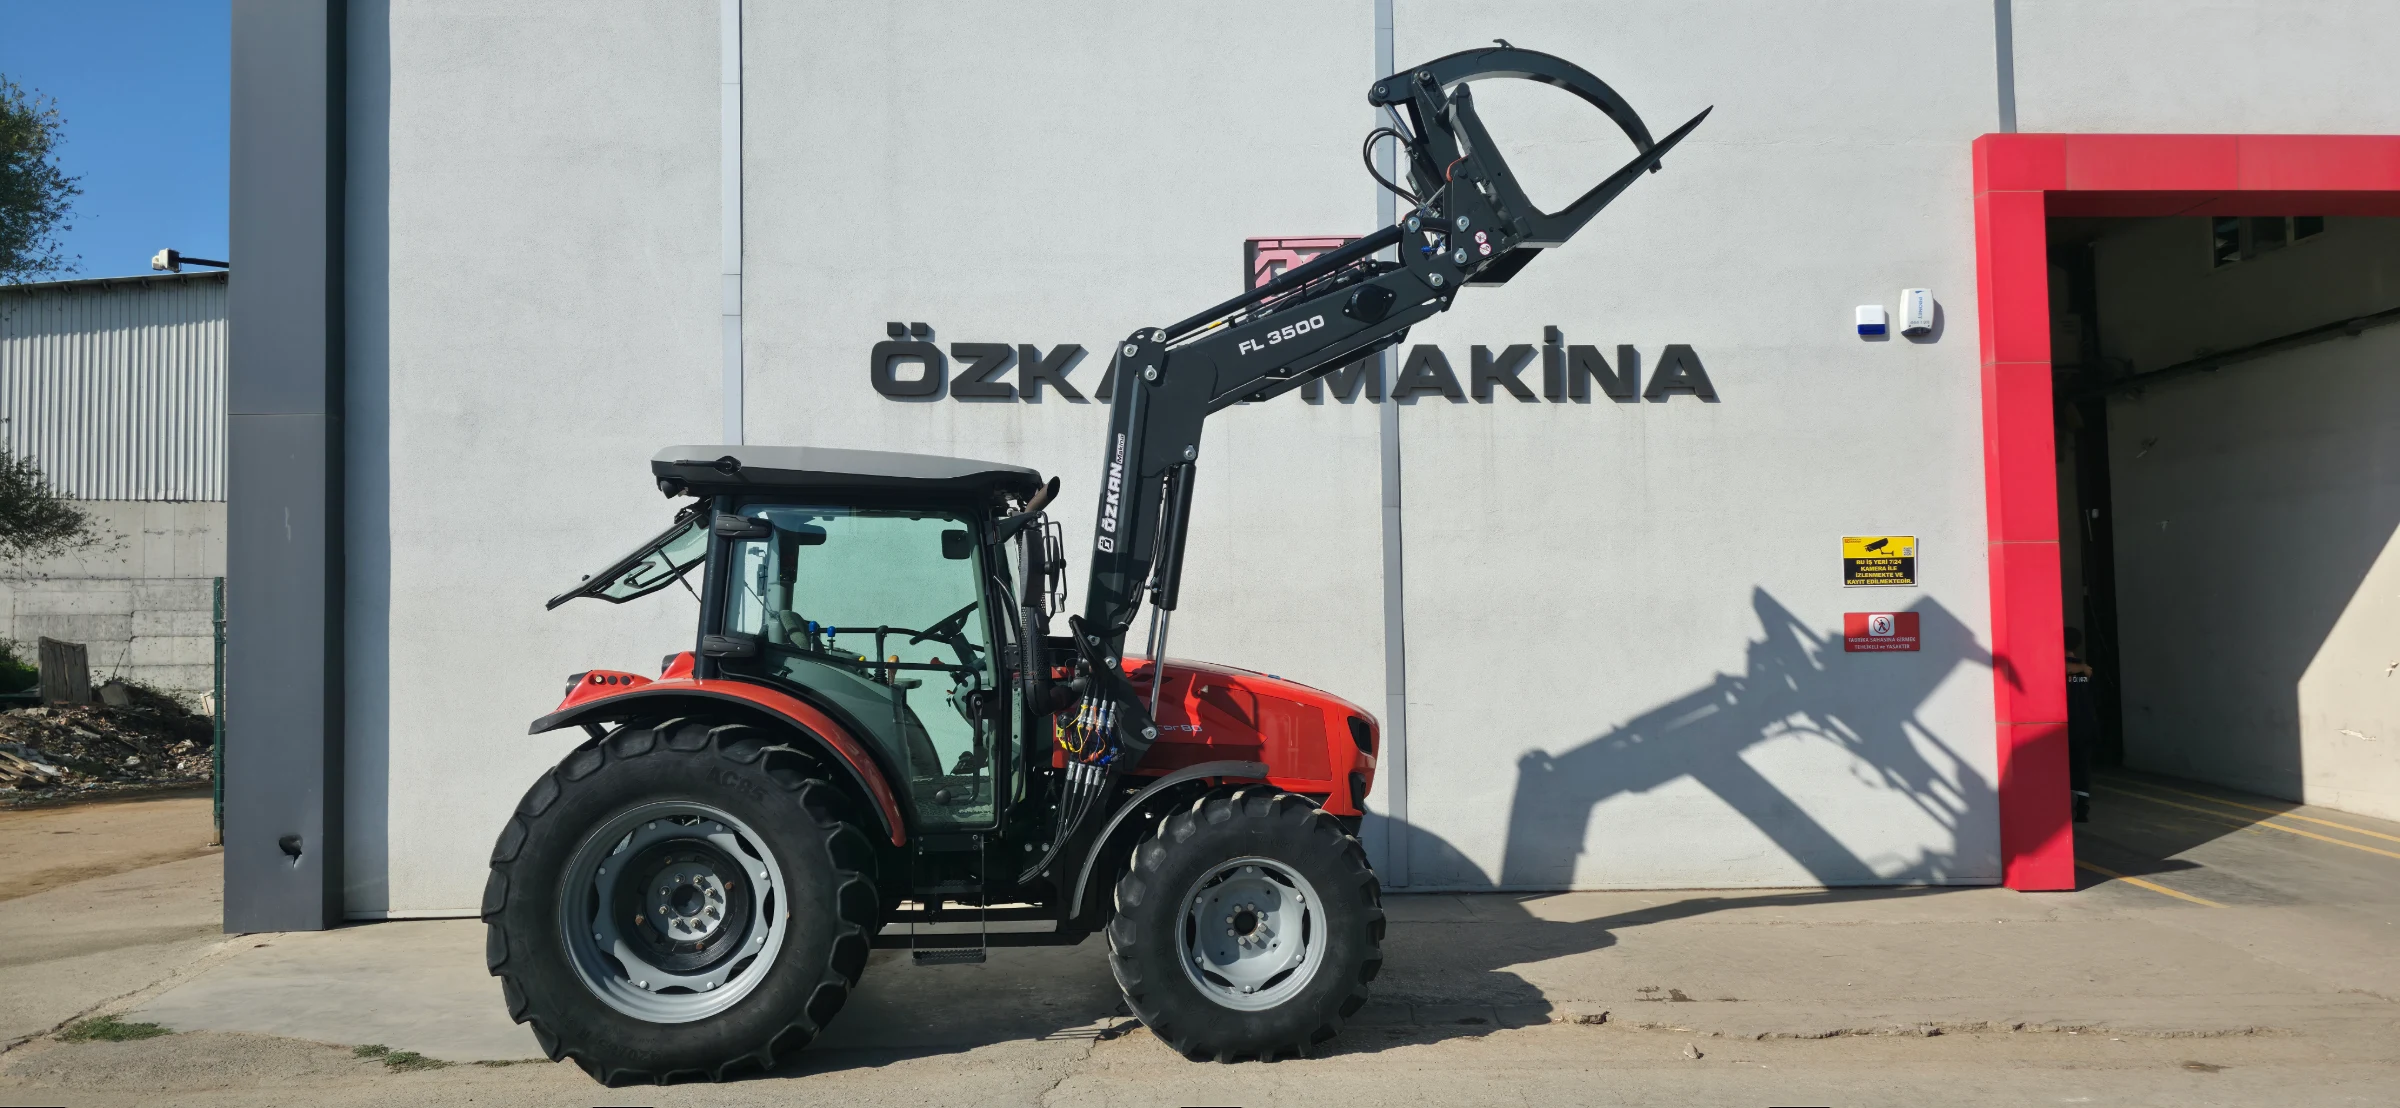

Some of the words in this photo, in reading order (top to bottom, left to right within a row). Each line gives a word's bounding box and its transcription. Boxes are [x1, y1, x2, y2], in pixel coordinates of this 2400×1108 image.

[1238, 338, 1265, 355] FL
[1267, 314, 1325, 345] 3500
[1101, 462, 1122, 533] ÖZKAN
